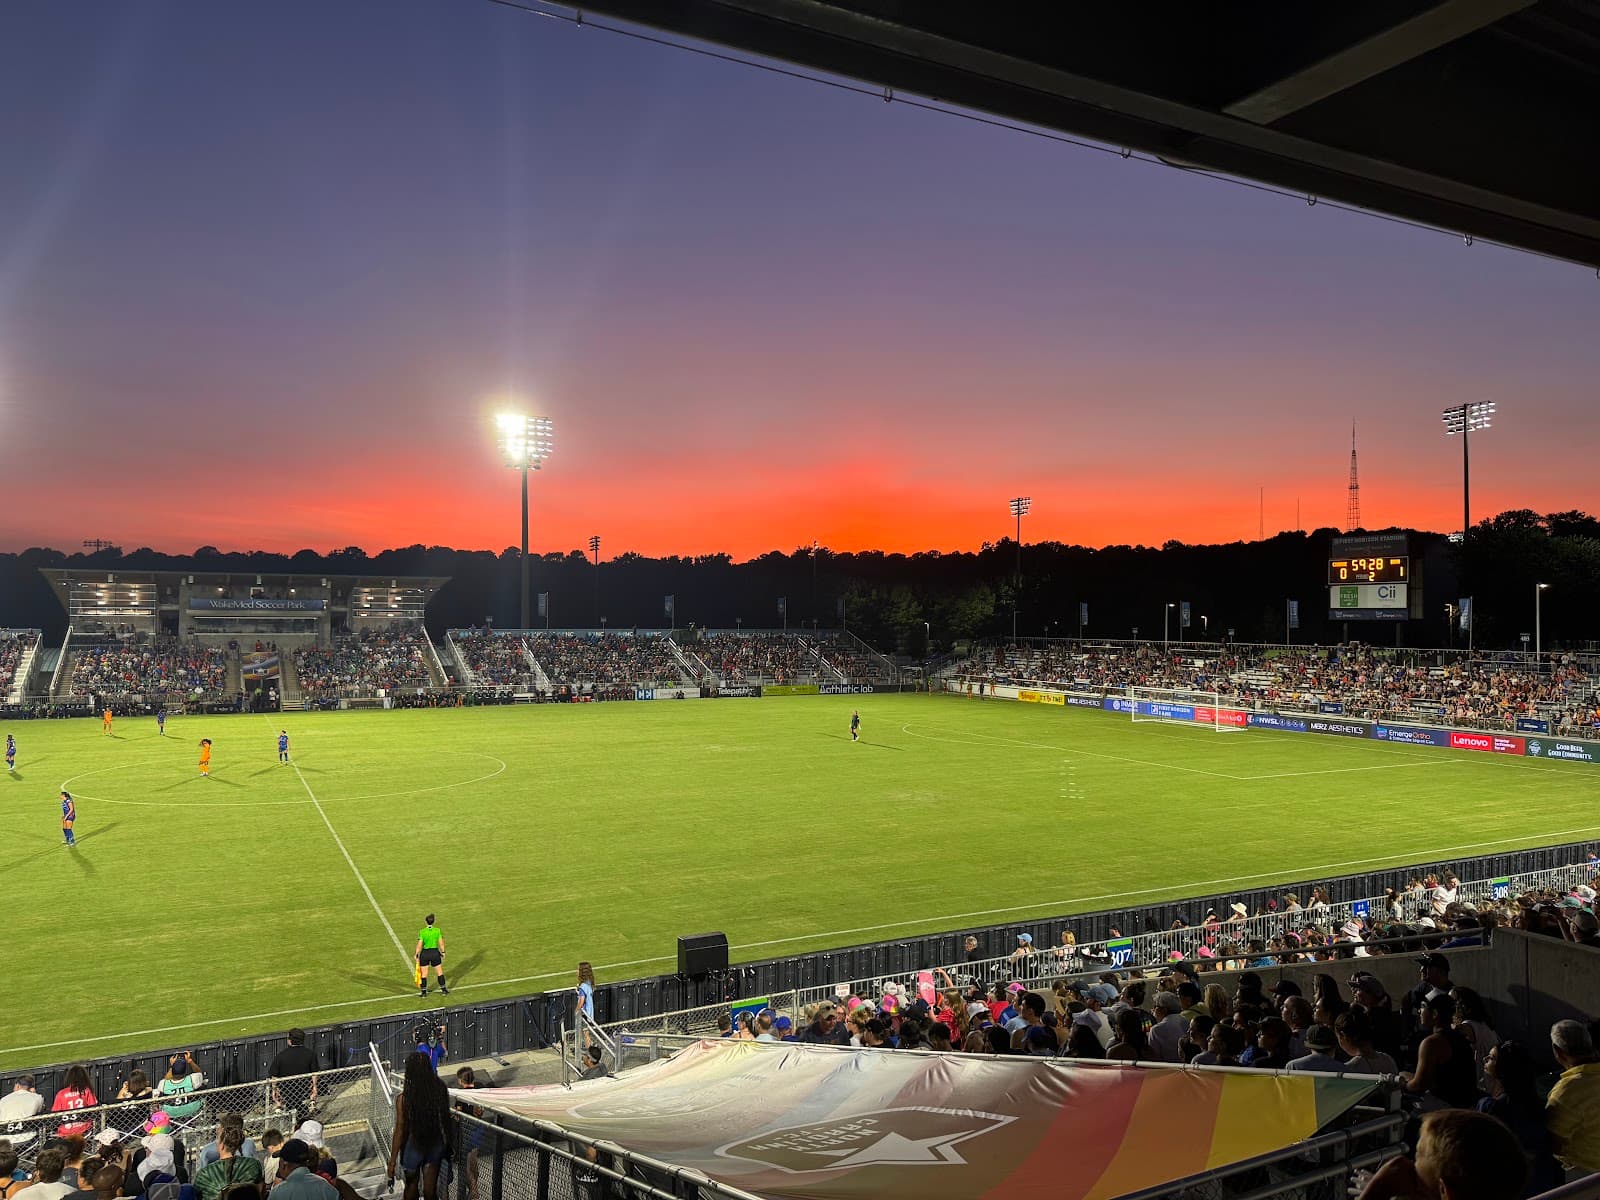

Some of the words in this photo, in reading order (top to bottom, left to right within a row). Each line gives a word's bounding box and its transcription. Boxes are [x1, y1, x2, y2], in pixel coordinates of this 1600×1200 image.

[1340, 567, 1347, 580] 0
[1368, 571, 1376, 582] 2
[1399, 566, 1404, 577] 1
[1377, 586, 1396, 599] Cii
[209, 600, 254, 609] WakeMed
[255, 600, 285, 609] Soccer
[287, 600, 305, 609] Park
[860, 684, 873, 693] lab
[1259, 717, 1280, 725] NWSL
[1311, 722, 1328, 731] MERZ
[1328, 724, 1364, 734] AESTHETICS
[1389, 729, 1431, 739] EmergeOrtho
[1453, 735, 1489, 747] Lenovo
[1494, 886, 1508, 901] 308
[1110, 948, 1132, 969] 307
[175, 1096, 187, 1105] 51
[7, 1121, 24, 1133] 54
[746, 1118, 880, 1151] CAROLINA
[787, 1129, 881, 1152] NORTH
